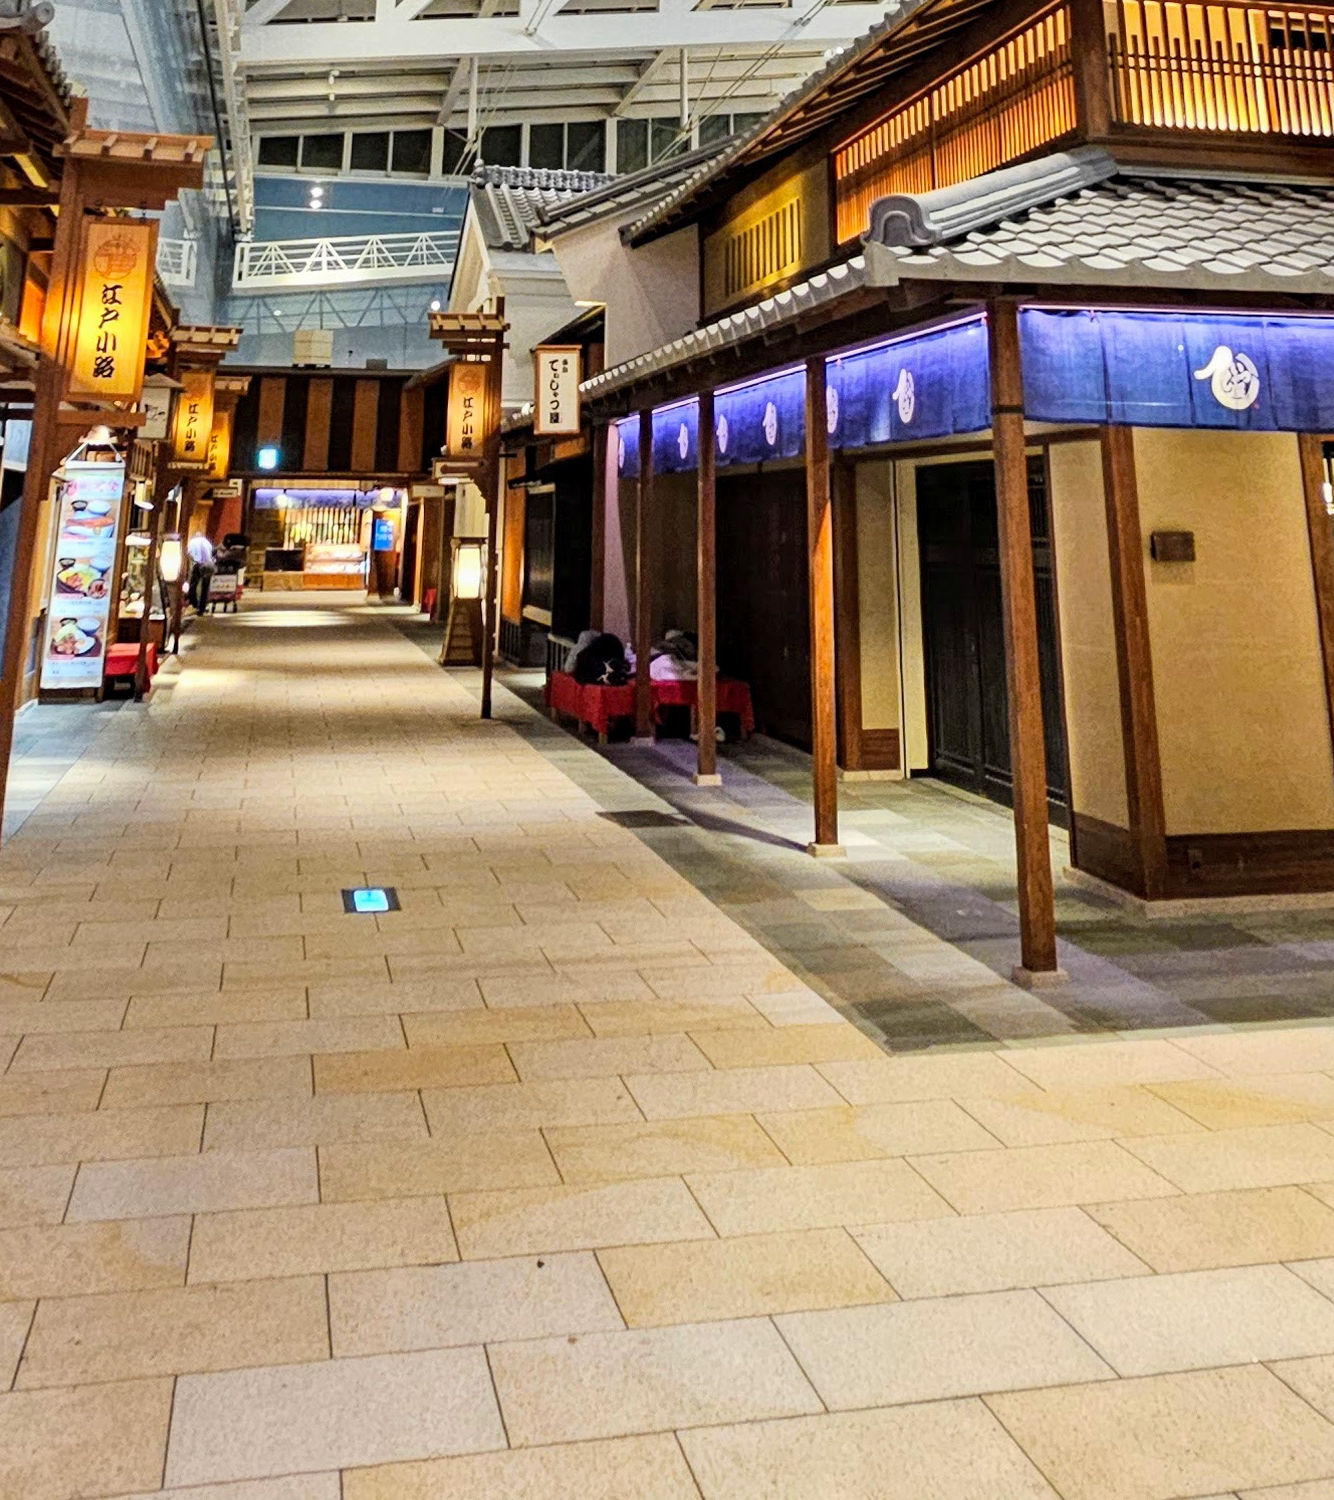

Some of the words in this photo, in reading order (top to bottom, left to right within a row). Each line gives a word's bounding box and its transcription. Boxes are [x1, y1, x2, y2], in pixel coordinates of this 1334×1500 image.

[92, 283, 124, 379] 江戸小路
[461, 396, 474, 450] 江戸小路
